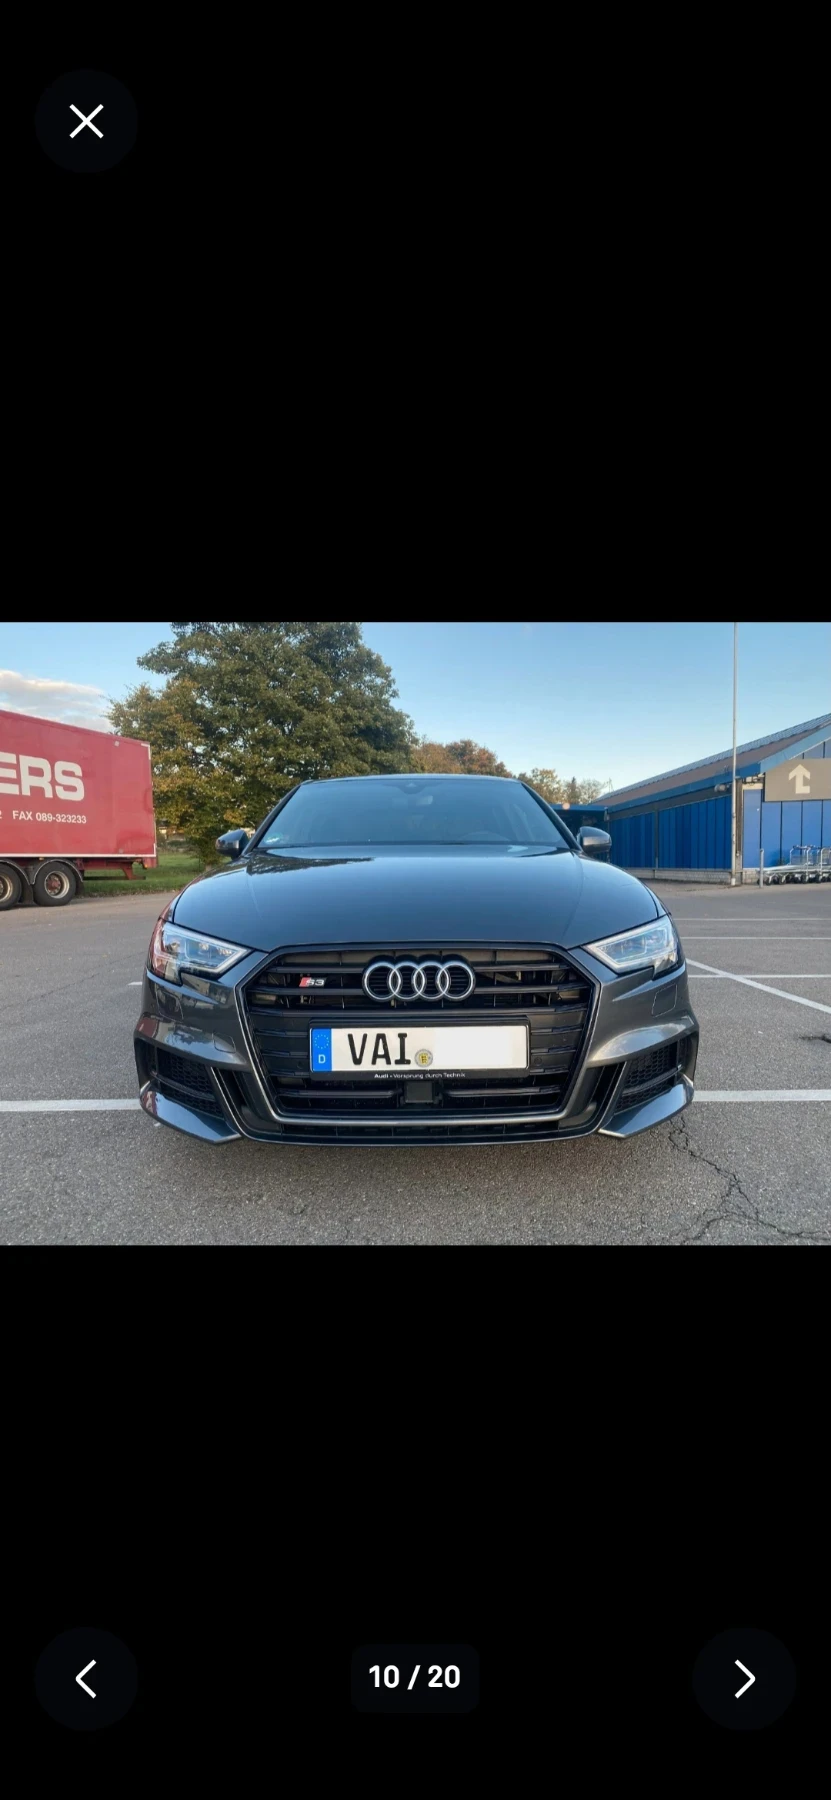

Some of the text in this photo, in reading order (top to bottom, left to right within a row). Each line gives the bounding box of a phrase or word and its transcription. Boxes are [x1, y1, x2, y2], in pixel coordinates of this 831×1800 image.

[12, 810, 33, 821] FAX
[35, 812, 87, 824] 089-323233
[347, 1032, 411, 1066] VAI
[318, 1054, 326, 1064] D
